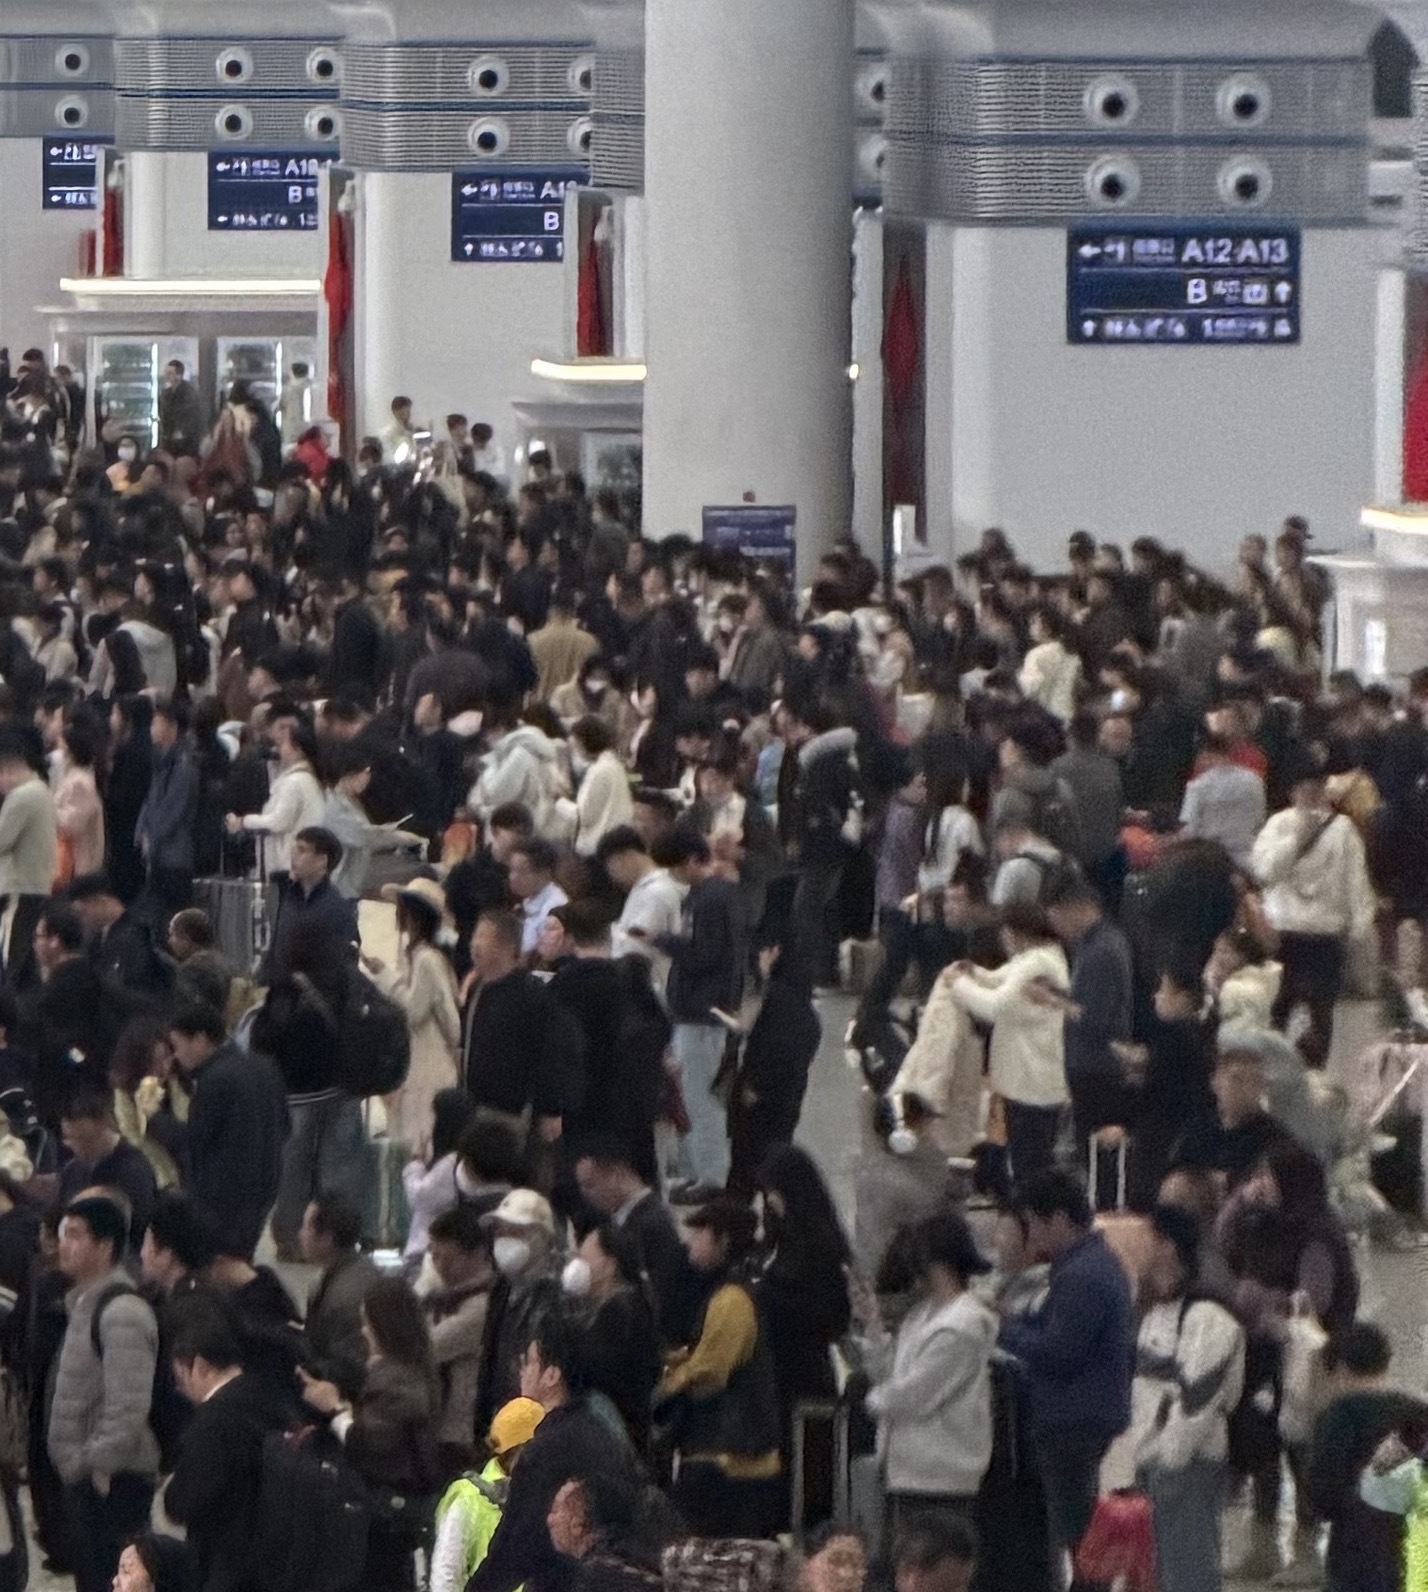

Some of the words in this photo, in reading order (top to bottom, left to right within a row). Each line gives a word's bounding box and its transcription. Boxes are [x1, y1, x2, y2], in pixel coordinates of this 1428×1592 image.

[544, 211, 559, 231] B
[1181, 238, 1232, 263] A12
[1236, 238, 1289, 263] A13
[1187, 278, 1207, 304] B
